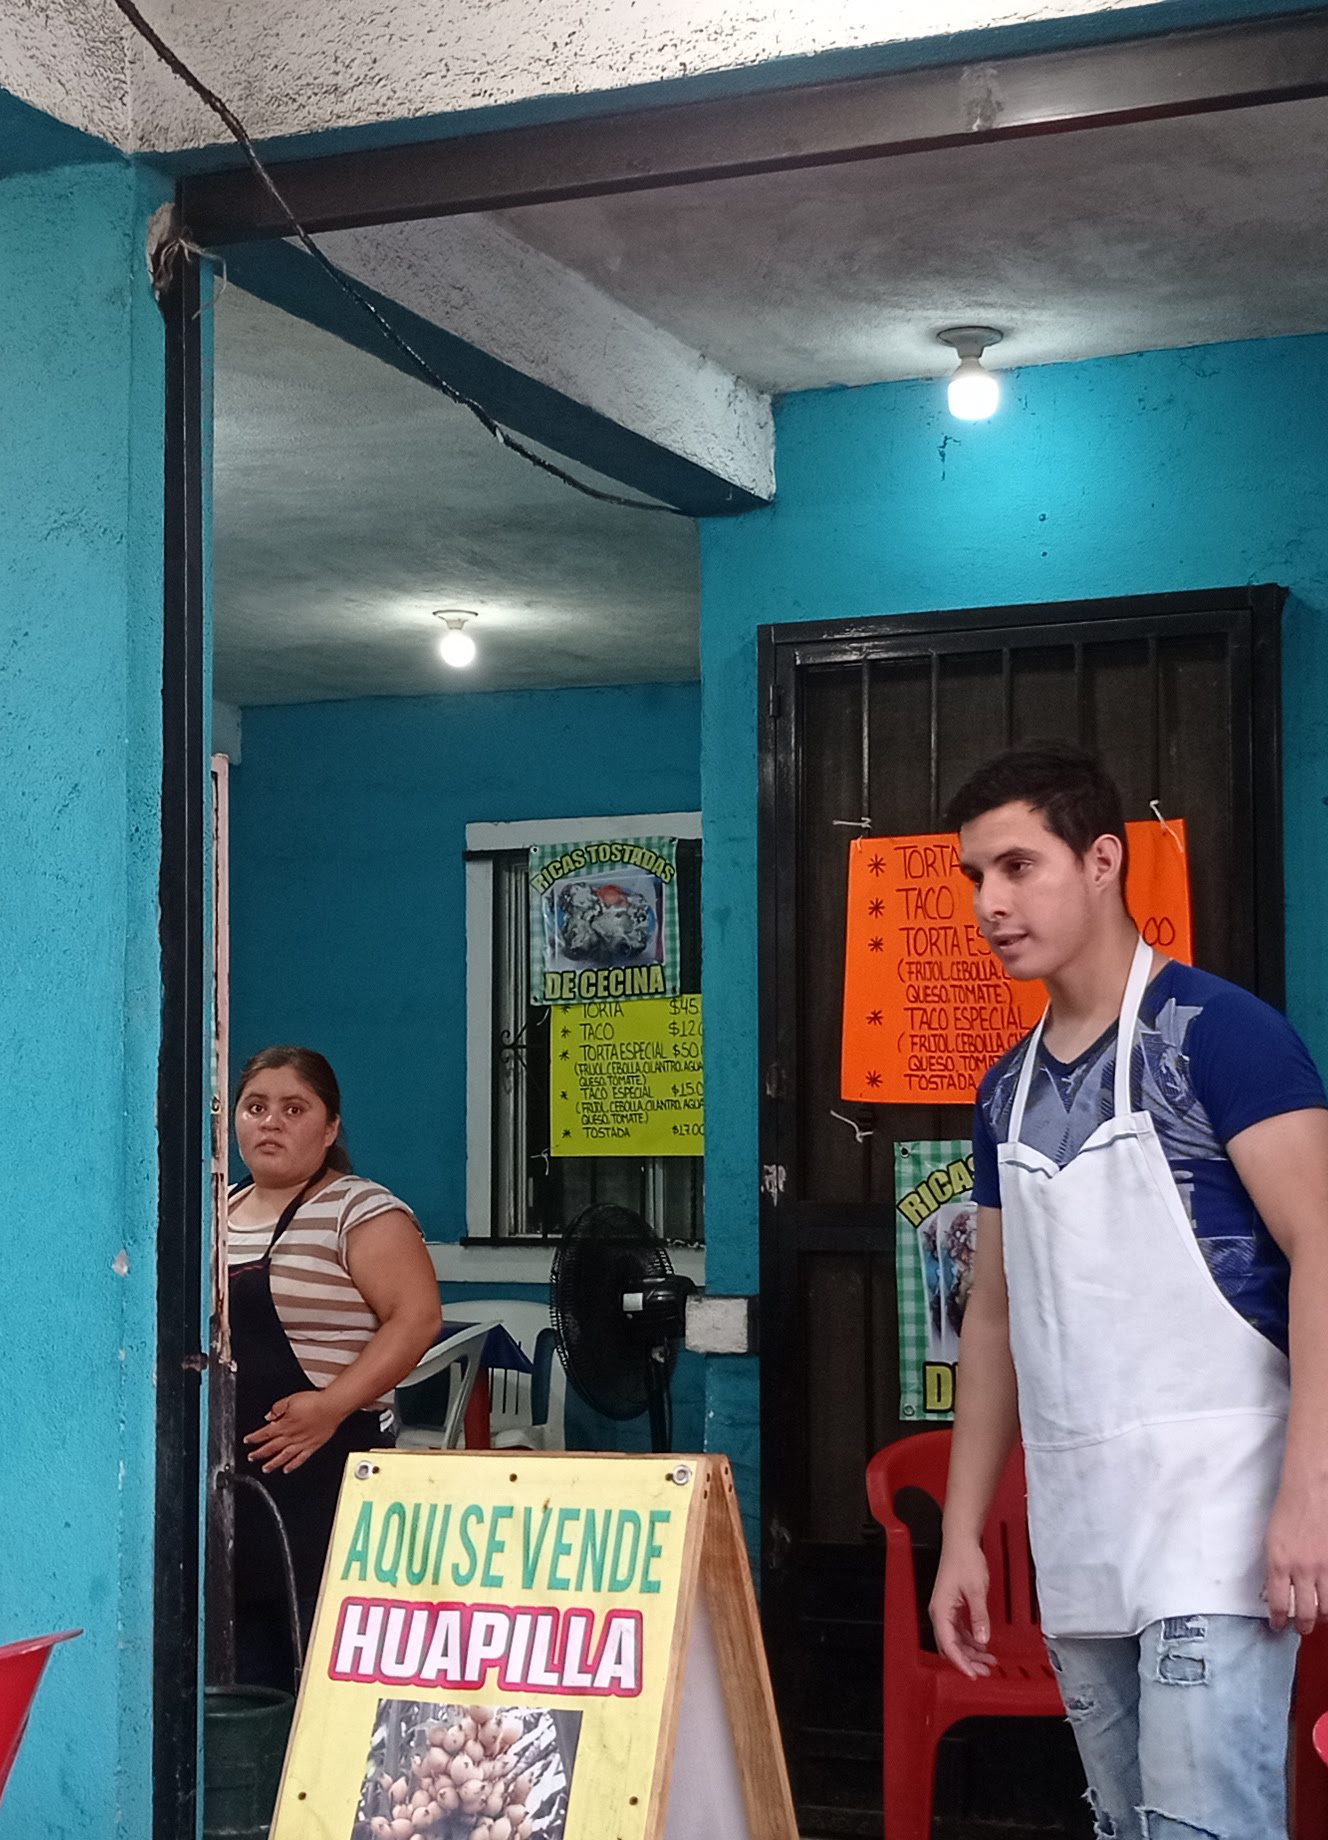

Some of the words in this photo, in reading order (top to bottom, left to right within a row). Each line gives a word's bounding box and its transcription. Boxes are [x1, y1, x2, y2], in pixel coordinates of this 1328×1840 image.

[531, 849, 586, 895] RICAS
[586, 842, 675, 884] TOSTADAS
[894, 845, 962, 879] TORTA
[895, 885, 954, 920] TACO
[898, 926, 962, 957] TORTA
[543, 970, 577, 1000] DE
[578, 963, 666, 999] CECINA
[582, 1002, 624, 1018] TORTA
[903, 1007, 948, 1031] TACO
[954, 1005, 1031, 1031] ESPECIAL
[579, 1022, 615, 1041] TACO
[579, 1044, 618, 1061] TORTA
[621, 1042, 668, 1060] ESPECIAL
[580, 1086, 608, 1100] TACO
[613, 1086, 654, 1099] ESPECIAL
[903, 1073, 977, 1091] TOSTADA
[582, 1126, 630, 1138] TOSTADA
[896, 1153, 974, 1228] RICA
[340, 1500, 451, 1589] AQUI
[452, 1503, 514, 1589] SE
[519, 1505, 671, 1594] VENDE
[330, 1598, 641, 1695] HUAPILLA
